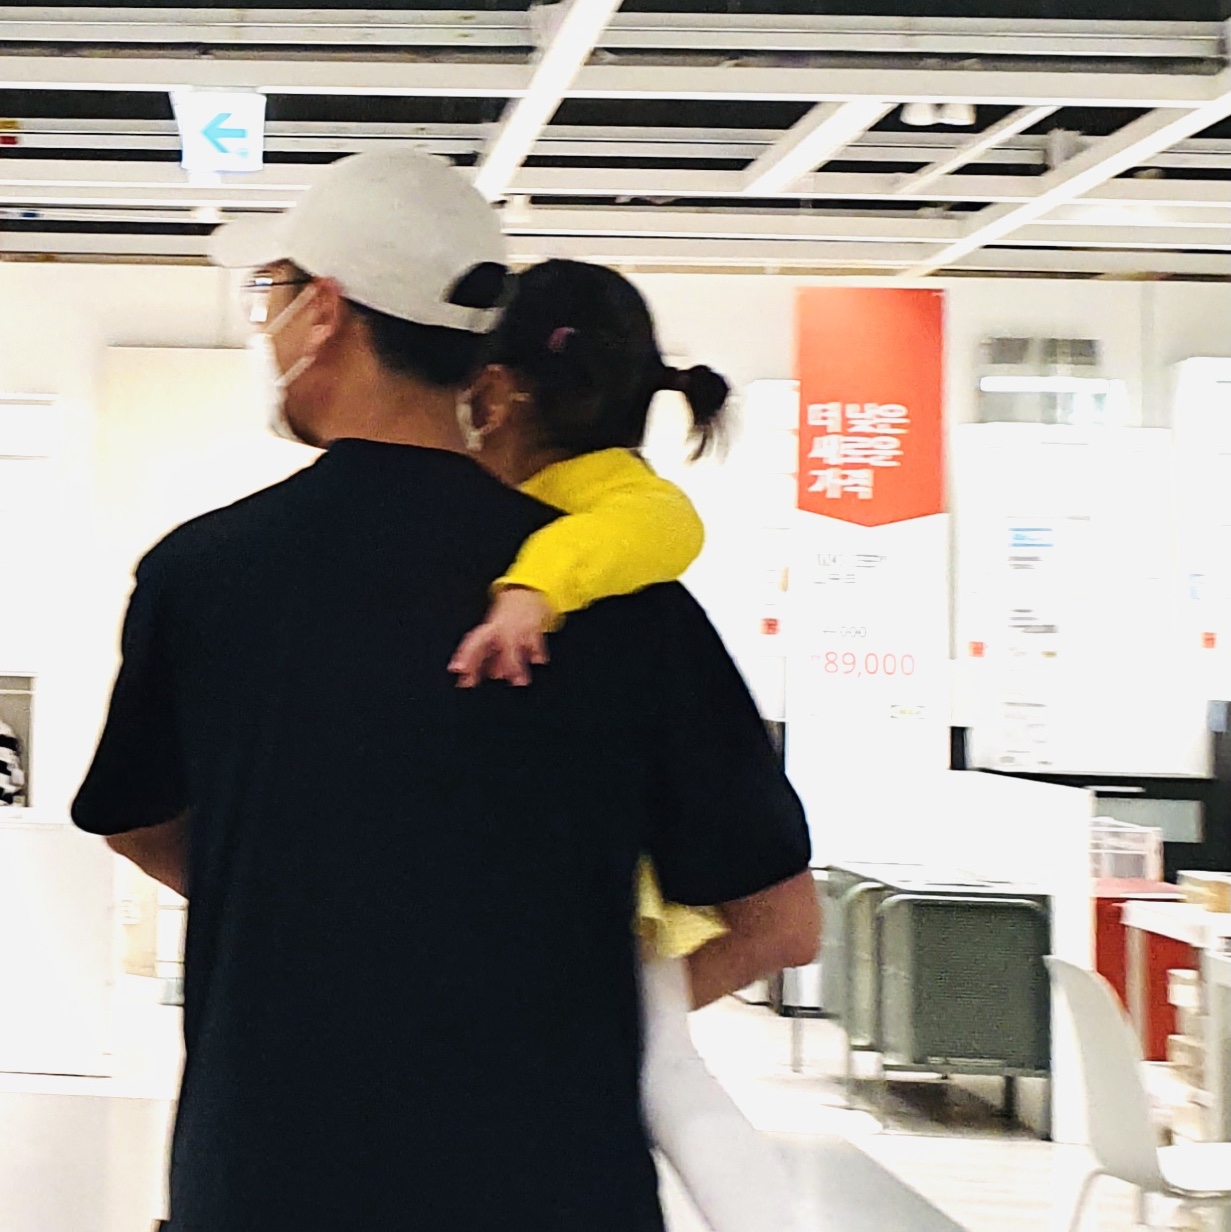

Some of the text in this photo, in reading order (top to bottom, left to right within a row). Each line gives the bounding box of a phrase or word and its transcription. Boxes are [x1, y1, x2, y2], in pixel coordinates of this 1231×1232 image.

[845, 402, 911, 435] 낮은
[807, 434, 904, 467] 새로운
[807, 467, 874, 500] 가격
